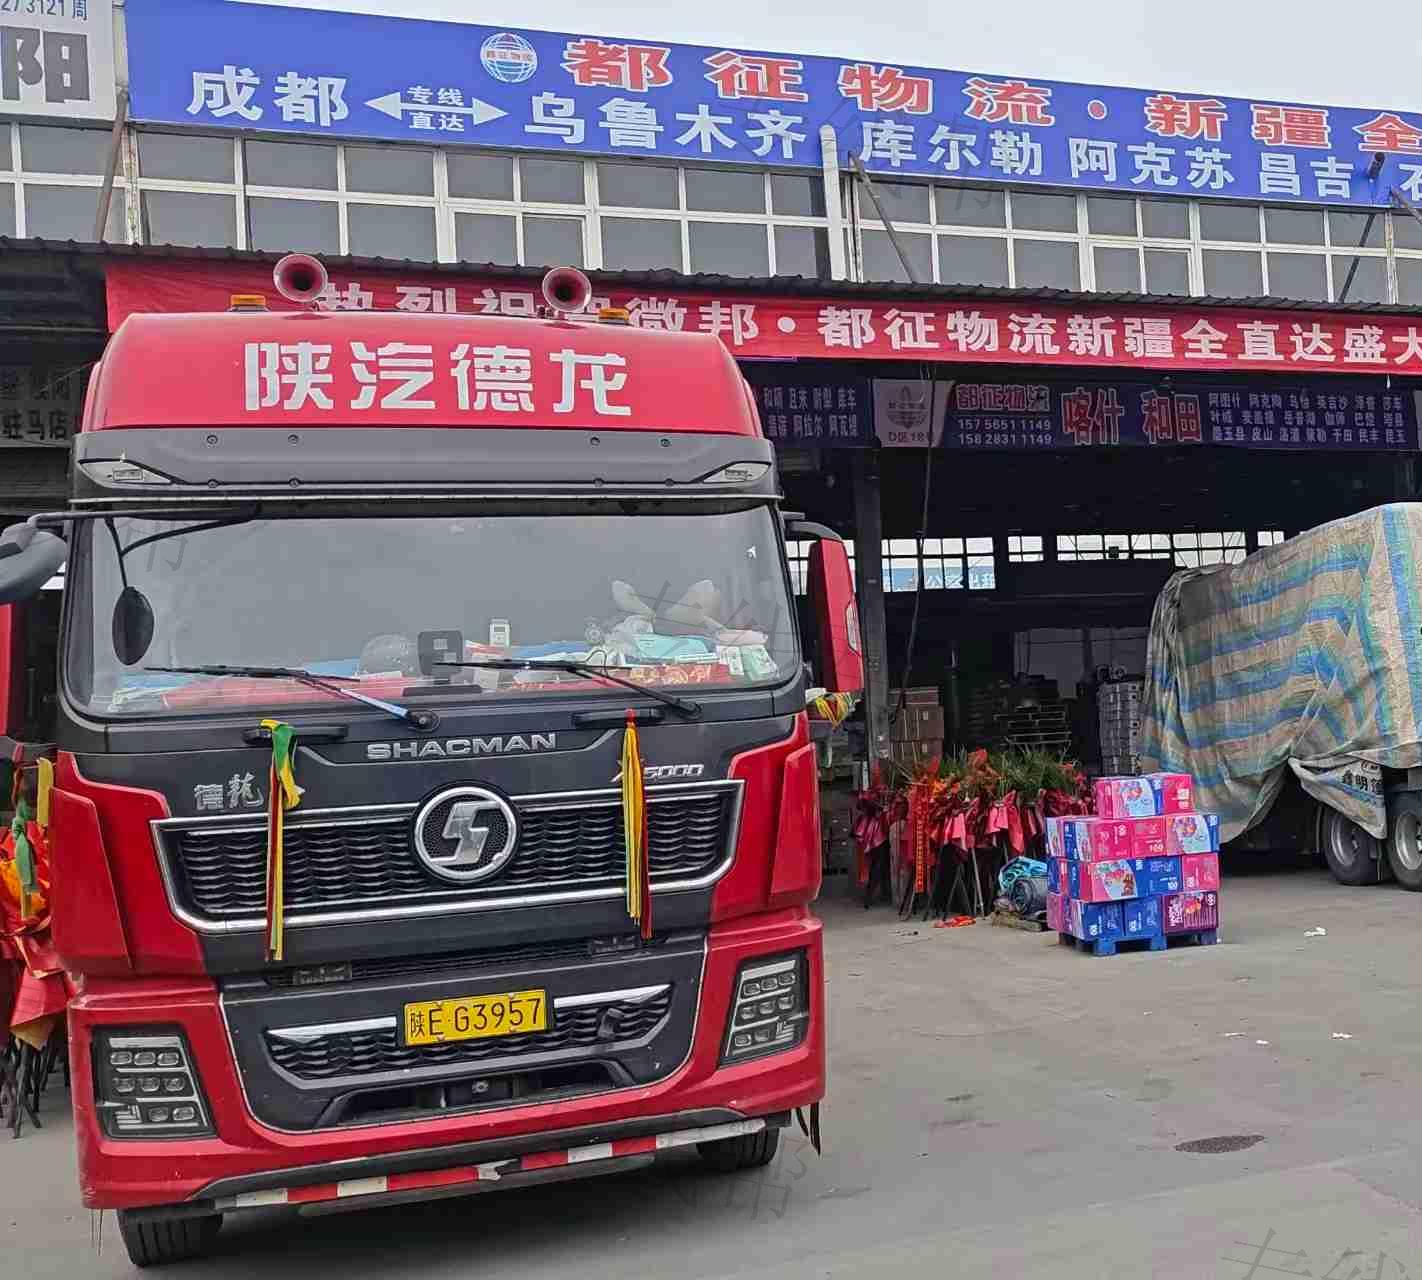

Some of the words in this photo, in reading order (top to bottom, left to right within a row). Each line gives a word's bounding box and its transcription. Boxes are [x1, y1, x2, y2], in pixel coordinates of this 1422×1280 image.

[407, 86, 465, 106] 专线
[185, 65, 350, 127] 成都
[524, 92, 807, 159] 乌鲁木齐
[858, 120, 1044, 177] 库尔勒
[1069, 137, 1235, 190] 阿克苏
[1259, 152, 1354, 199] 昌吉
[408, 112, 465, 132] 直达
[243, 341, 632, 417] 陕汽德龙
[955, 383, 1051, 412] 都征物流
[1061, 386, 1125, 447] 喀什
[1139, 390, 1202, 445] 和田
[366, 732, 558, 760] SHACMAN
